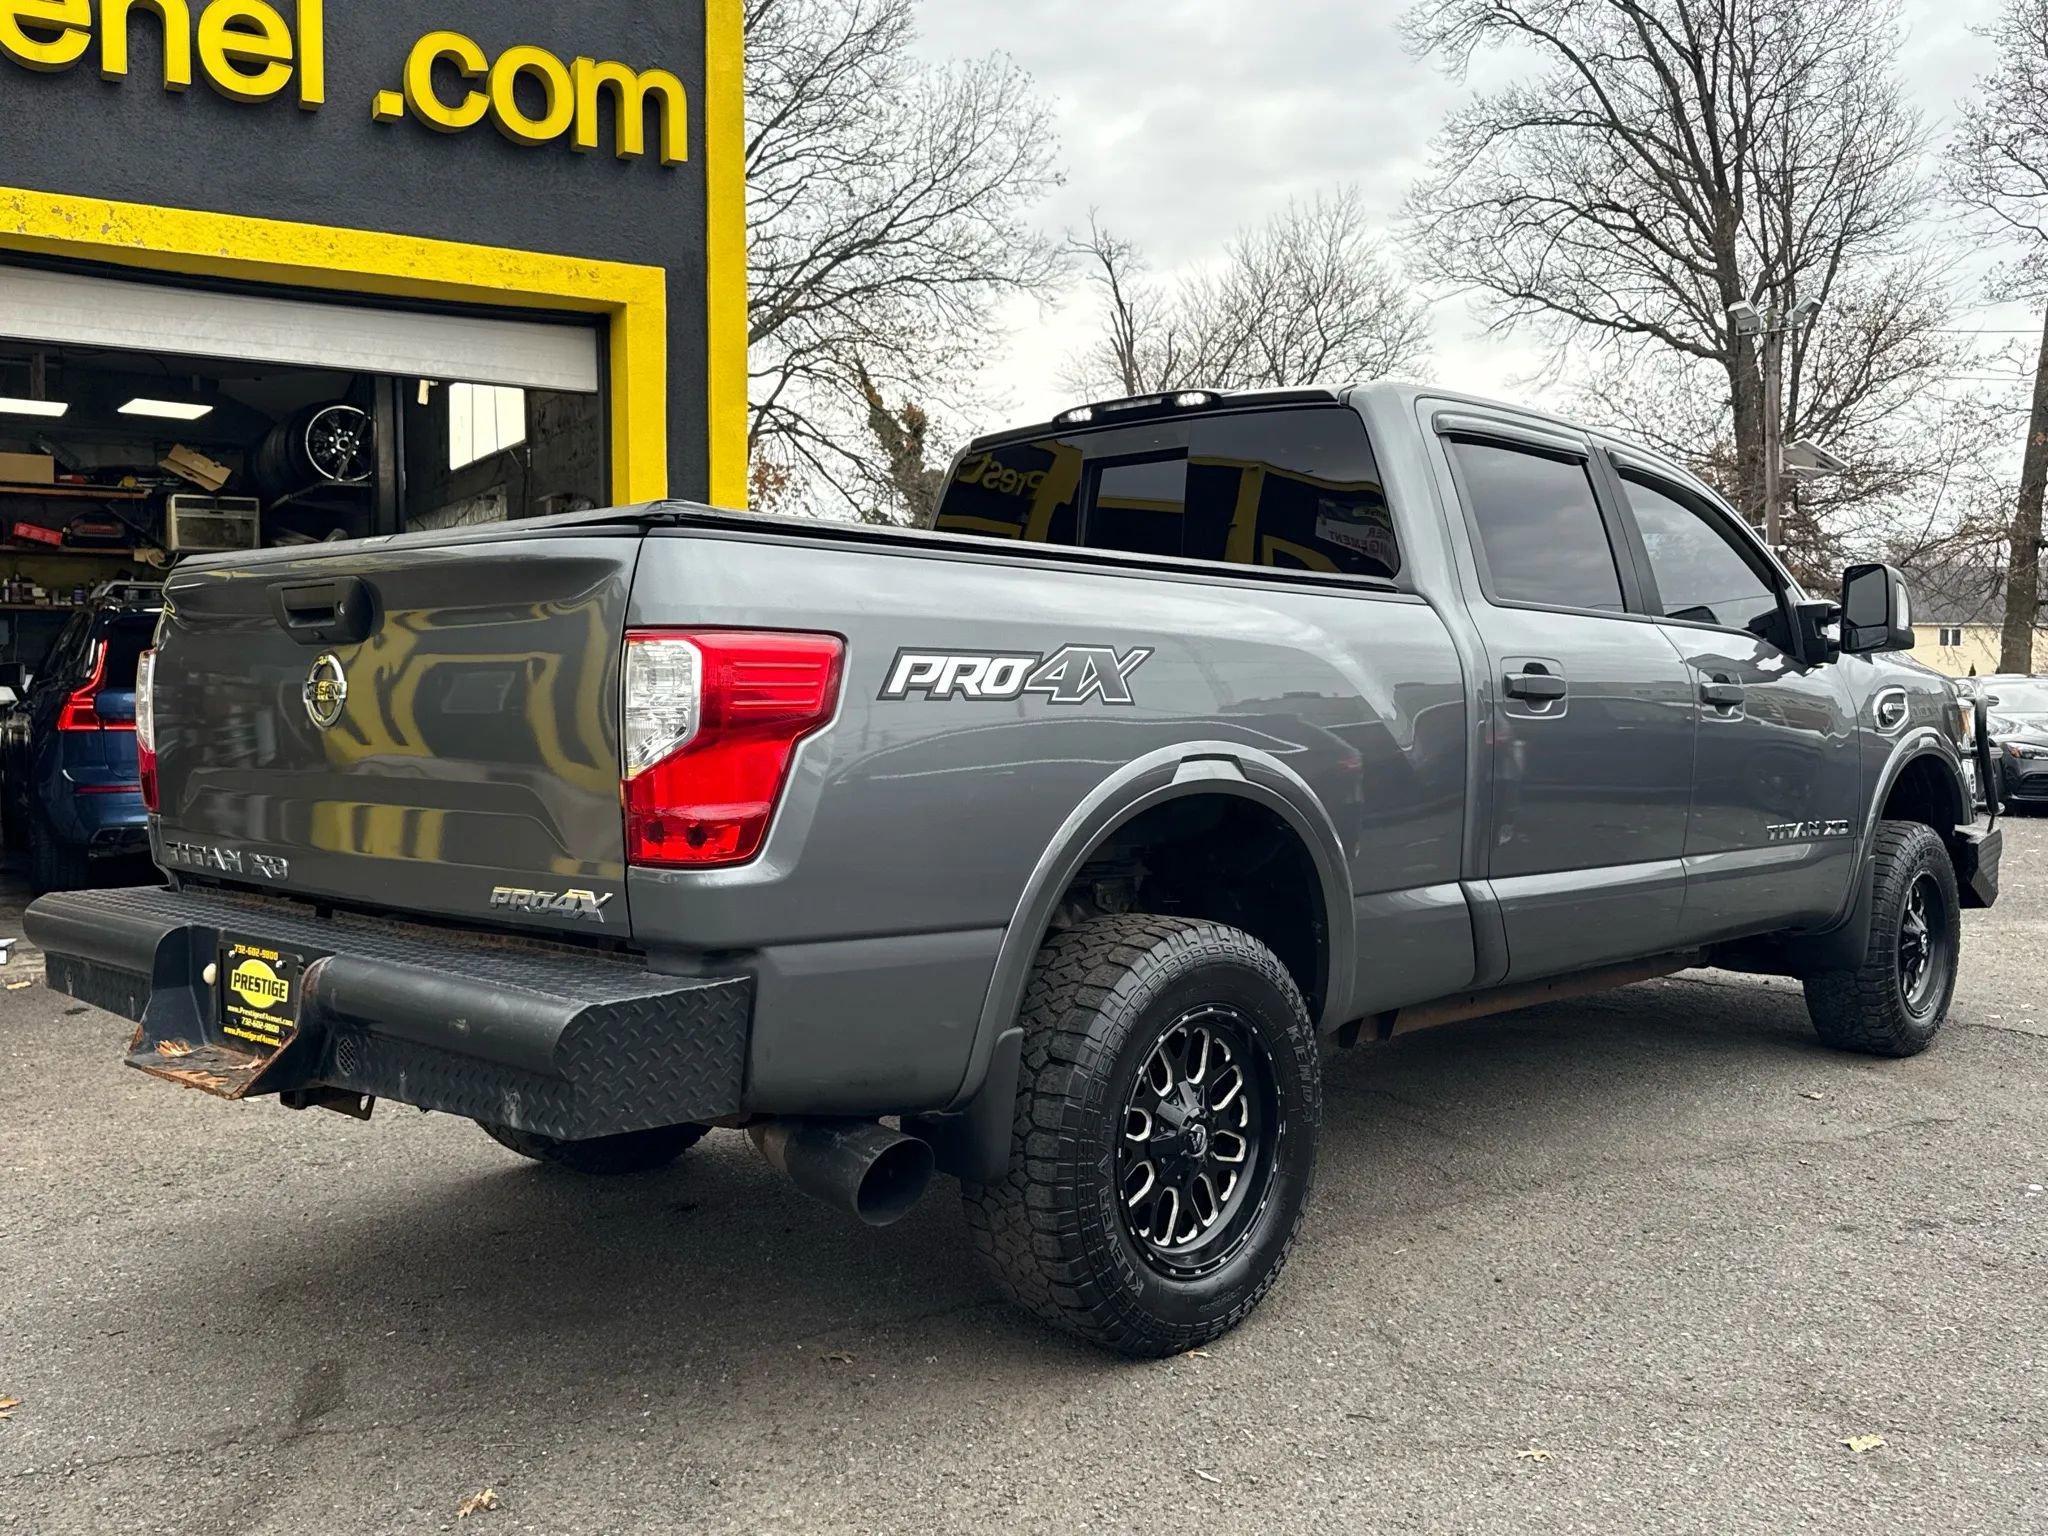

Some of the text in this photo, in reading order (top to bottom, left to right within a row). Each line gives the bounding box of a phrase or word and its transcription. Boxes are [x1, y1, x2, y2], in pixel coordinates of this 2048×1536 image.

[372, 31, 689, 167] .com
[876, 643, 1155, 706] PRO4X
[1766, 819, 1849, 840] TITAN XD
[165, 841, 243, 873] TITAN
[490, 886, 614, 923] PRO4X
[232, 972, 286, 999] PRESTIGE
